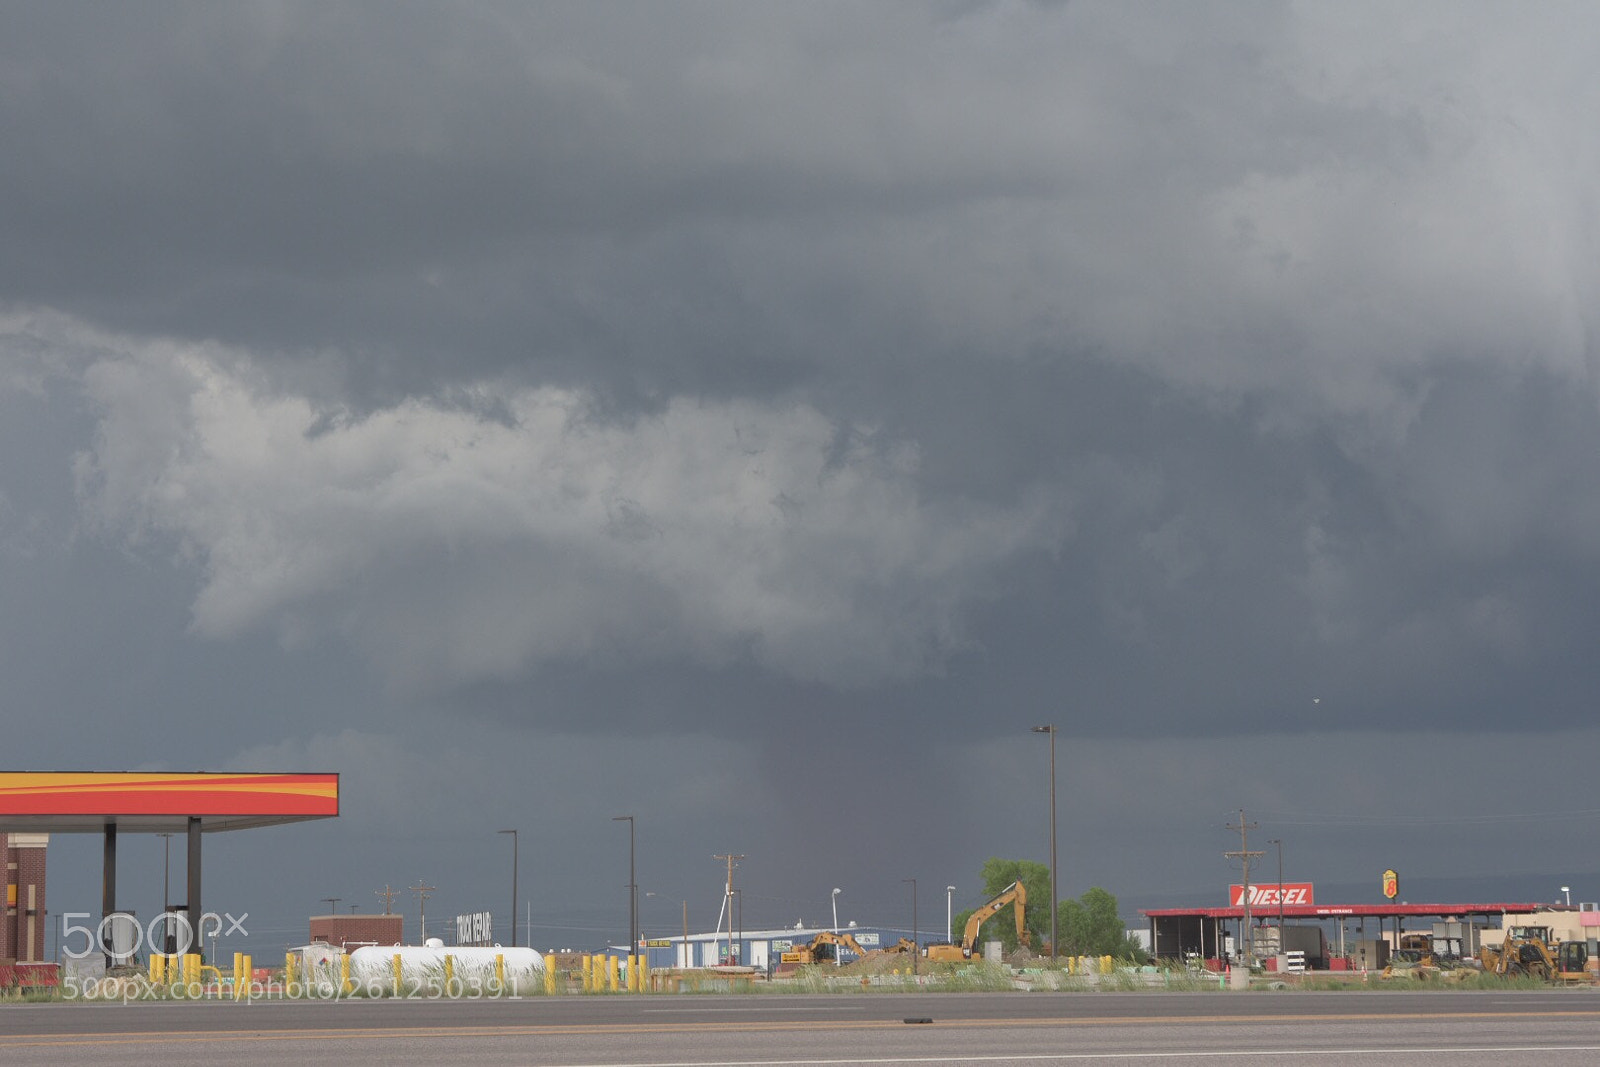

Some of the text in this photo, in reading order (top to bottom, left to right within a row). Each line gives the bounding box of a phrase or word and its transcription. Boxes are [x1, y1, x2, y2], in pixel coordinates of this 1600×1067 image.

[1235, 886, 1307, 906] DIESEL
[1386, 879, 1396, 897] 8
[456, 914, 473, 944] TRUCK
